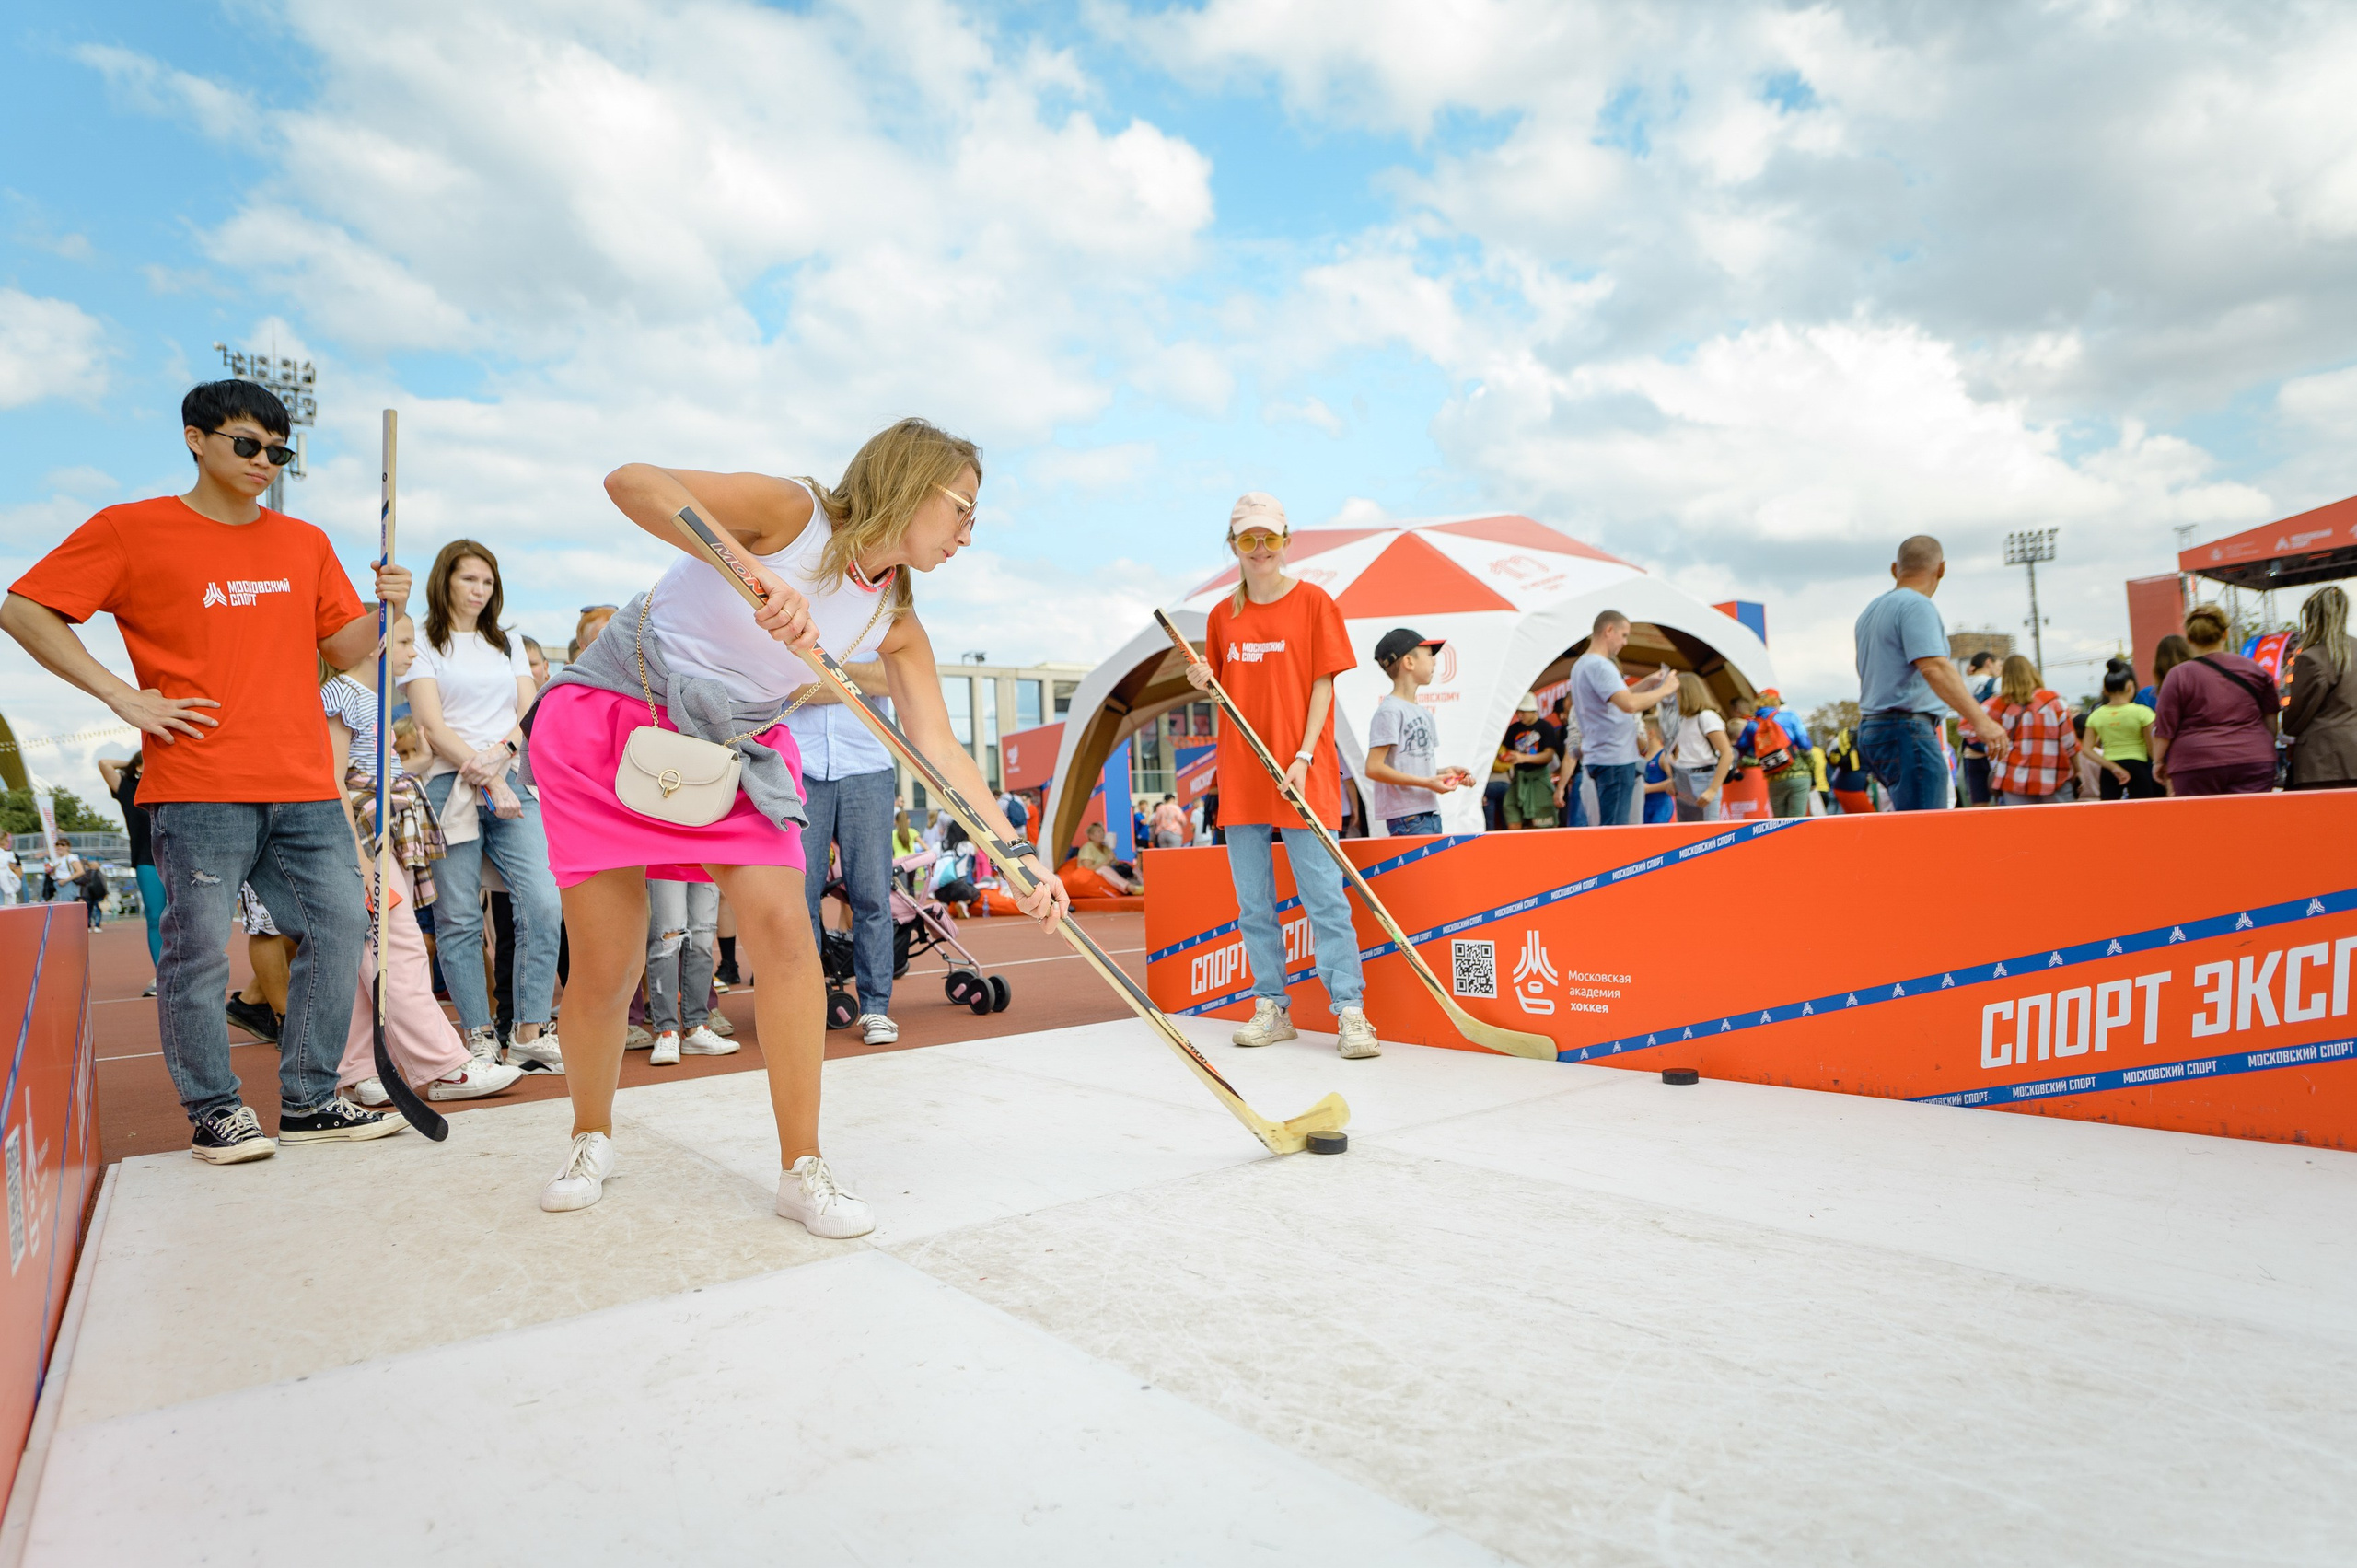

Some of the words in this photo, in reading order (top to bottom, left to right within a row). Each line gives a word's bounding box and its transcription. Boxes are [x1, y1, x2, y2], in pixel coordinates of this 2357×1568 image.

[226, 578, 291, 594] МОСКОВСКИЙ
[229, 593, 257, 607] СПОРТ
[1241, 652, 1264, 663] СПОРТ
[1242, 640, 1285, 653] МОСКОВСКИЙ
[830, 668, 863, 697] SR
[1679, 838, 1716, 859] МОСКОВСКИЙ
[1717, 833, 1736, 847] СПОРТ
[1612, 860, 1646, 881] МОСКОВСКИЙ
[1647, 855, 1664, 870] СПОРТ
[1551, 881, 1582, 900] МОСКОВСКИЙ
[1583, 877, 1598, 890] СПОРТ
[373, 871, 381, 960] NORDWAY
[1495, 900, 1523, 919] МОСКОВСКИЙ
[1524, 897, 1538, 910] СПОРТ
[1191, 940, 1248, 996] СПОРТ
[1568, 970, 1631, 984] Московская
[1569, 987, 1621, 999] академия
[1570, 1002, 1609, 1013] хоккея
[1980, 970, 2172, 1069] СПОРТ
[2247, 1046, 2317, 1068] МОСКОВСКИЙ
[2320, 1040, 2355, 1059] СПОРТ
[2122, 1063, 2185, 1084] МОСКОВСКИЙ
[2187, 1060, 2217, 1075] СПОРТ
[1915, 1093, 1963, 1107] СКОВСКИЙ
[1964, 1086, 1989, 1104] СПОРТ
[2012, 1079, 2067, 1098] МОСКОВСКИЙ
[2069, 1076, 2096, 1090] СПОРТ
